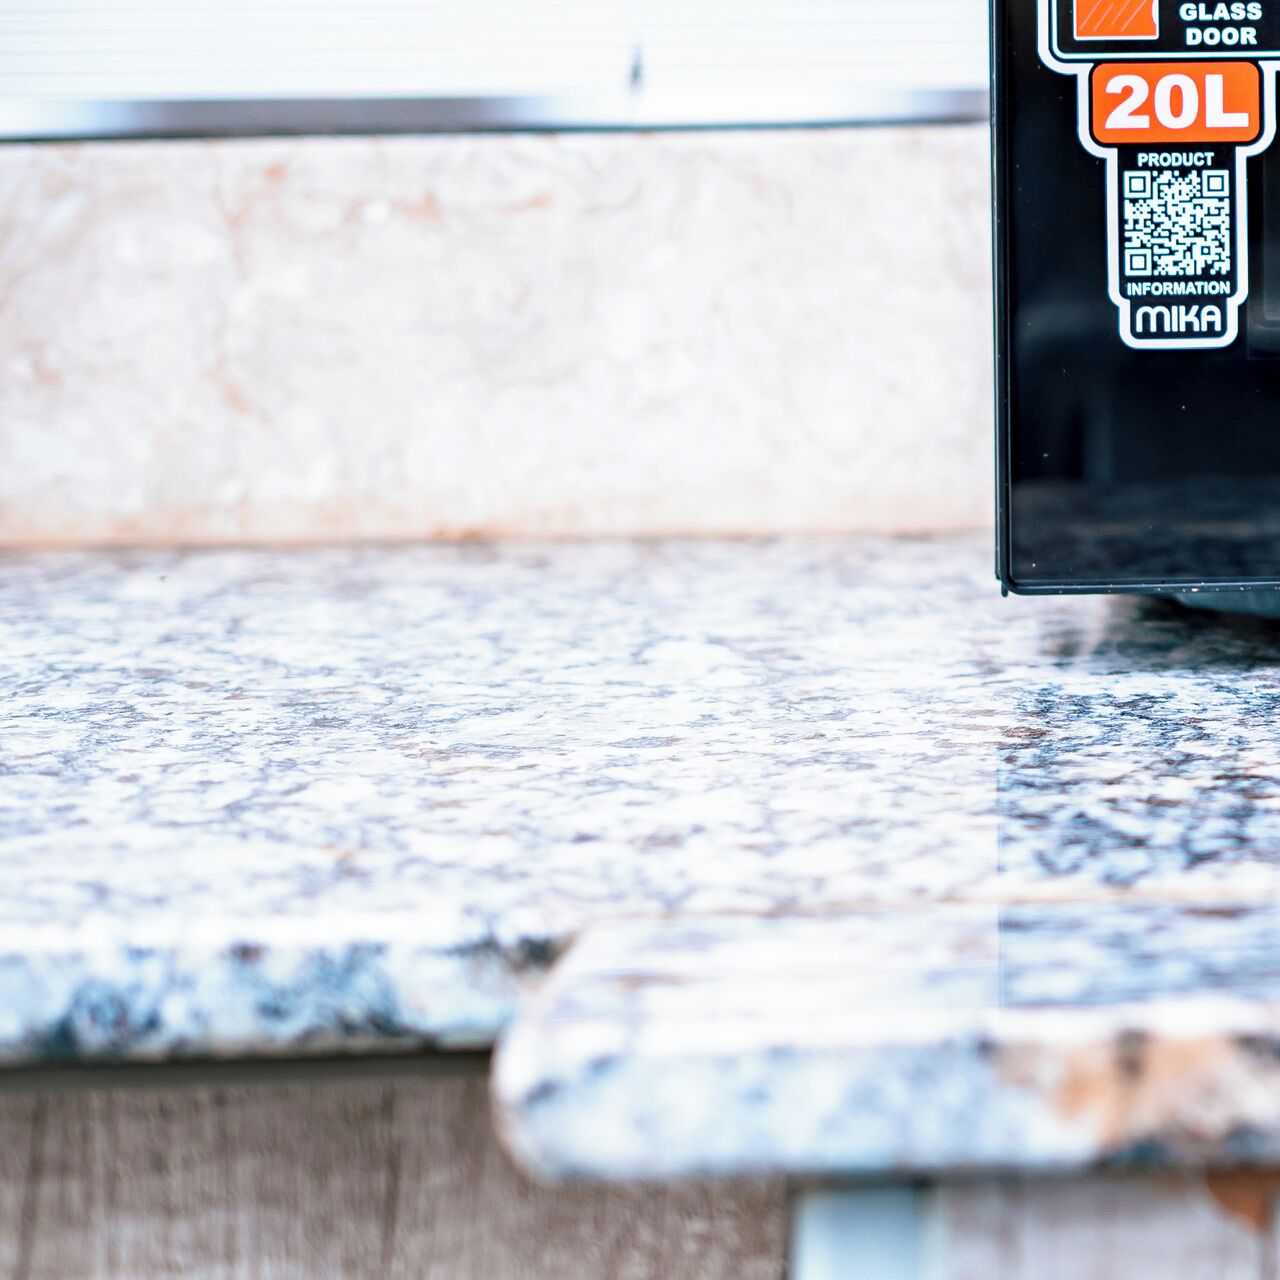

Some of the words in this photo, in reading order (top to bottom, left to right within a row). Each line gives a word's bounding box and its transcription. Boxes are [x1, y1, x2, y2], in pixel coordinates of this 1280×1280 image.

[1179, 2, 1263, 21] GLASS
[1185, 26, 1258, 46] DOOR
[1104, 73, 1250, 130] 20L
[1137, 151, 1215, 167] PRODUCT
[1126, 280, 1231, 296] INFORMATION
[1135, 304, 1222, 333] MIKA
